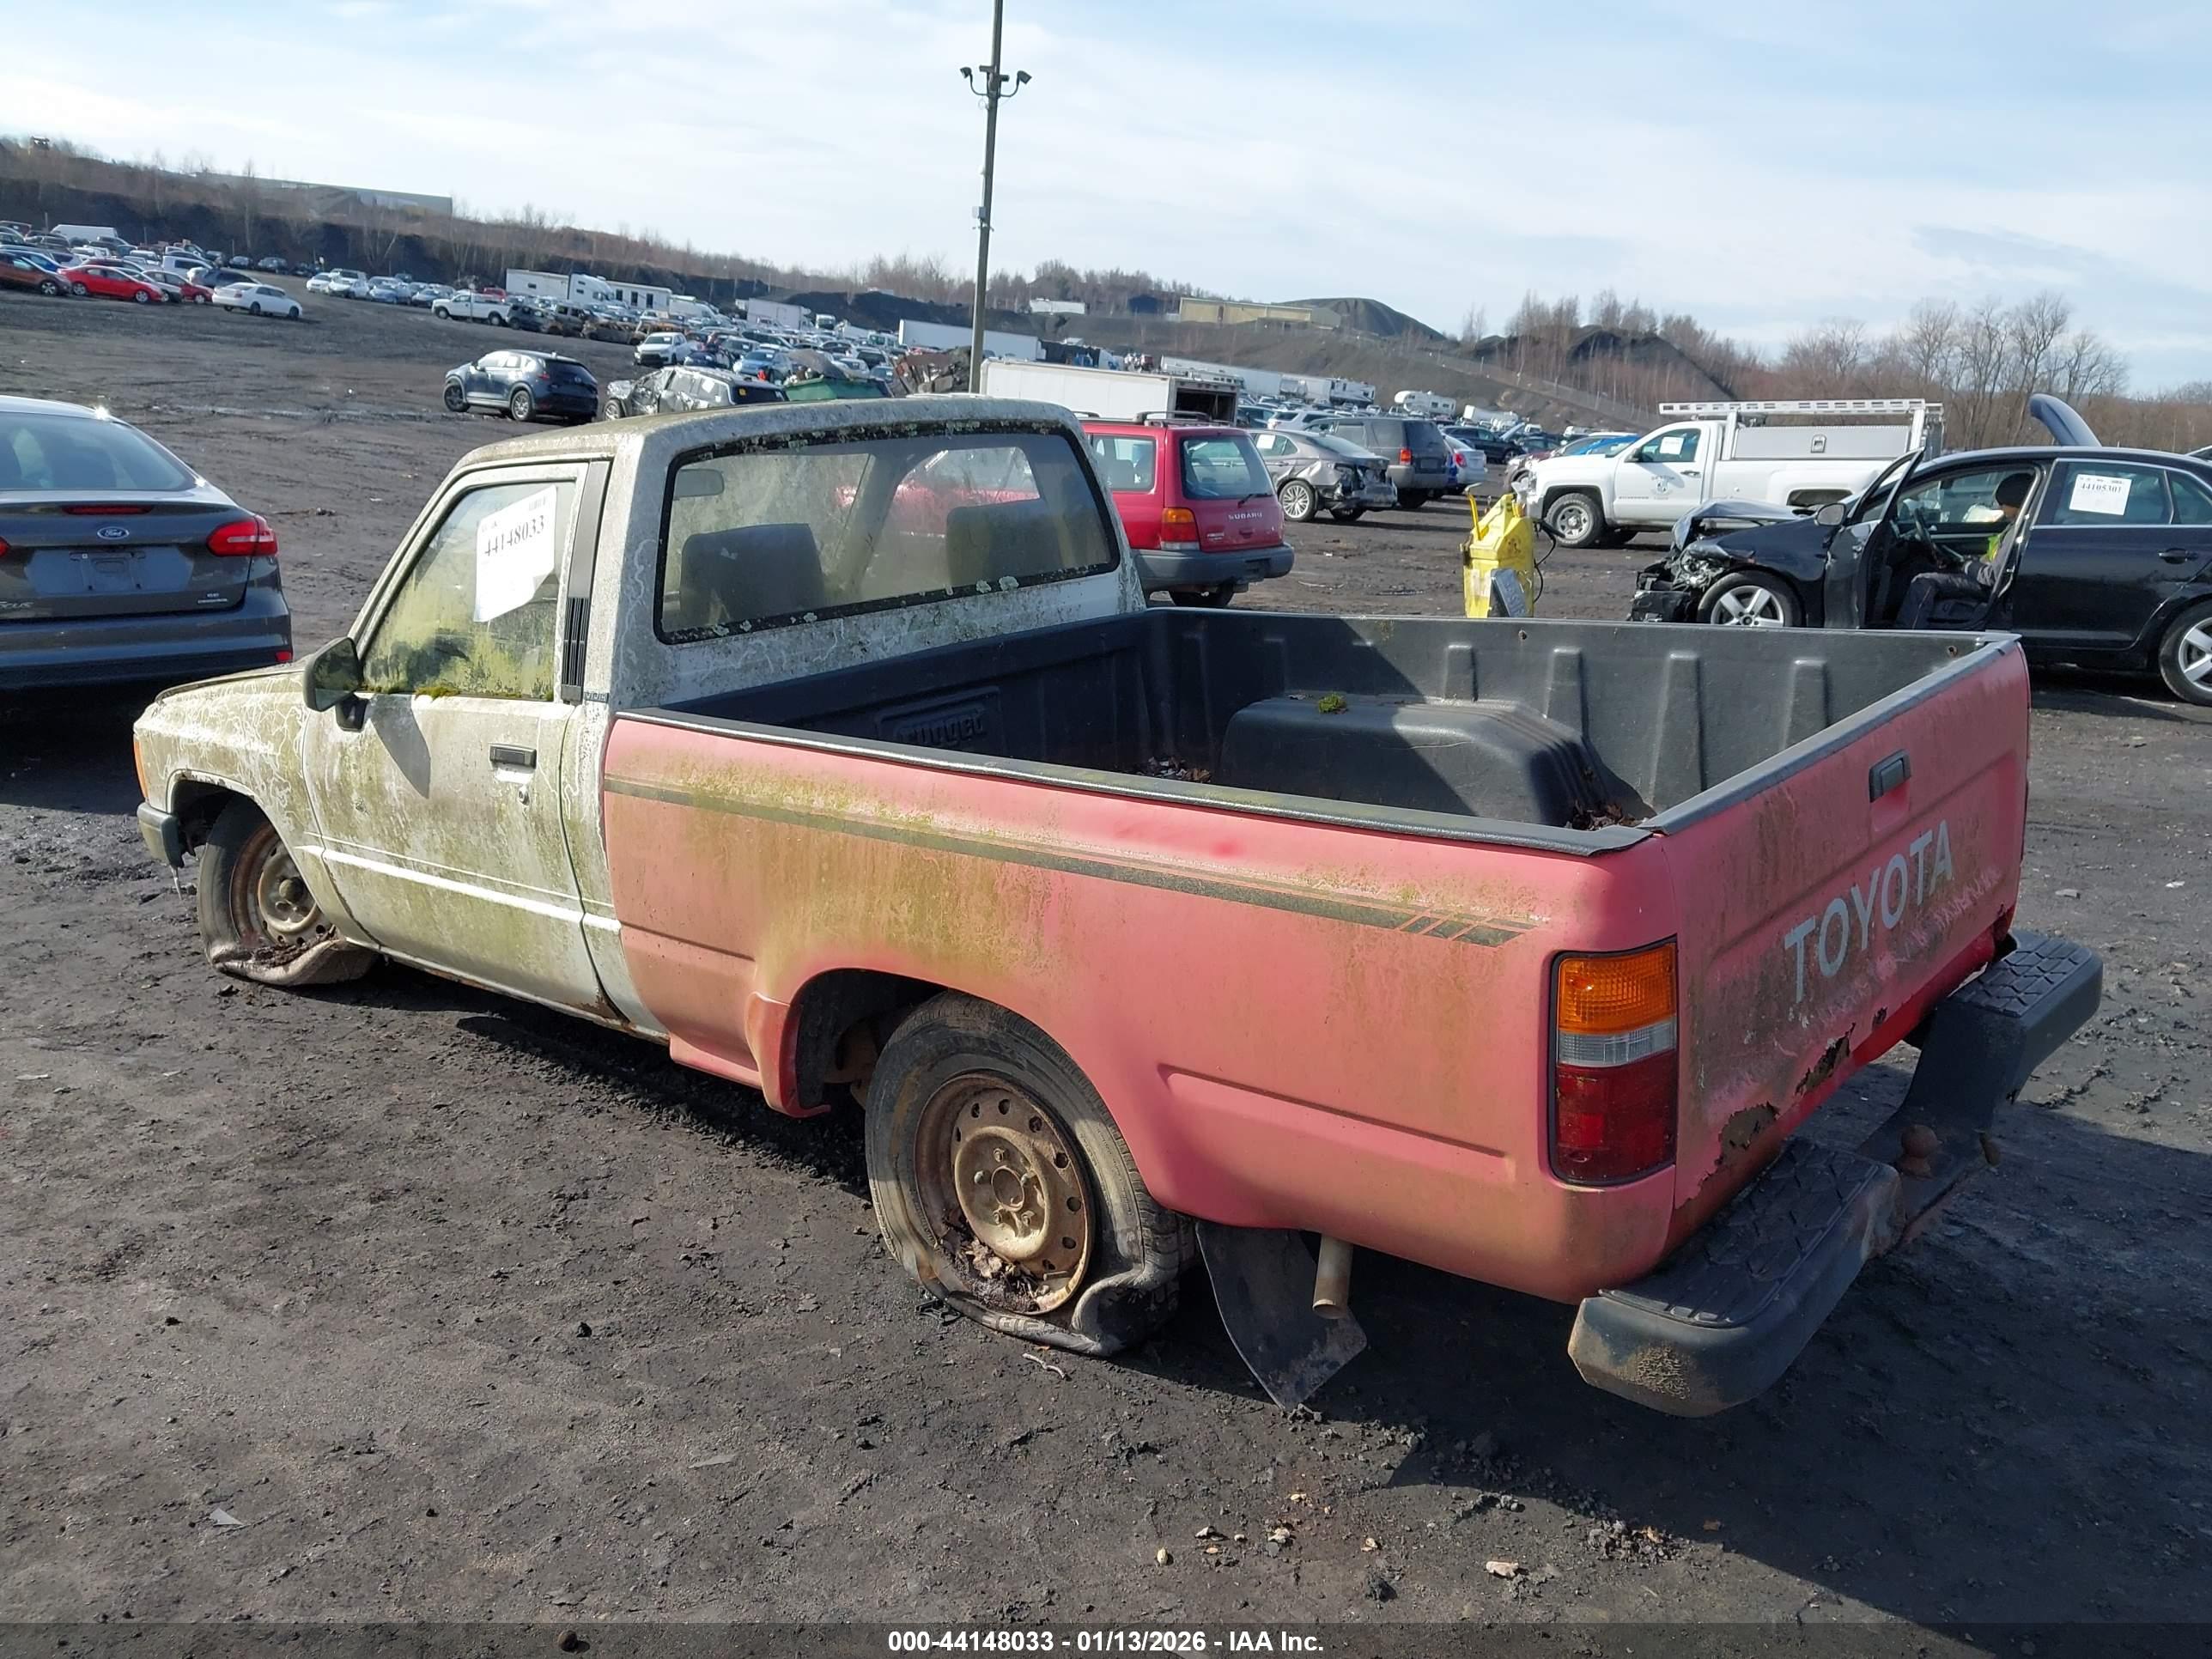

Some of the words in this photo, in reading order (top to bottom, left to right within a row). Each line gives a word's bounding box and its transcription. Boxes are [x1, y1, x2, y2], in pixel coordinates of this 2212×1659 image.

[484, 514, 545, 557] 44148033
[1228, 511, 1263, 520] SUBARU
[1784, 818, 1954, 1004] TOYOTA
